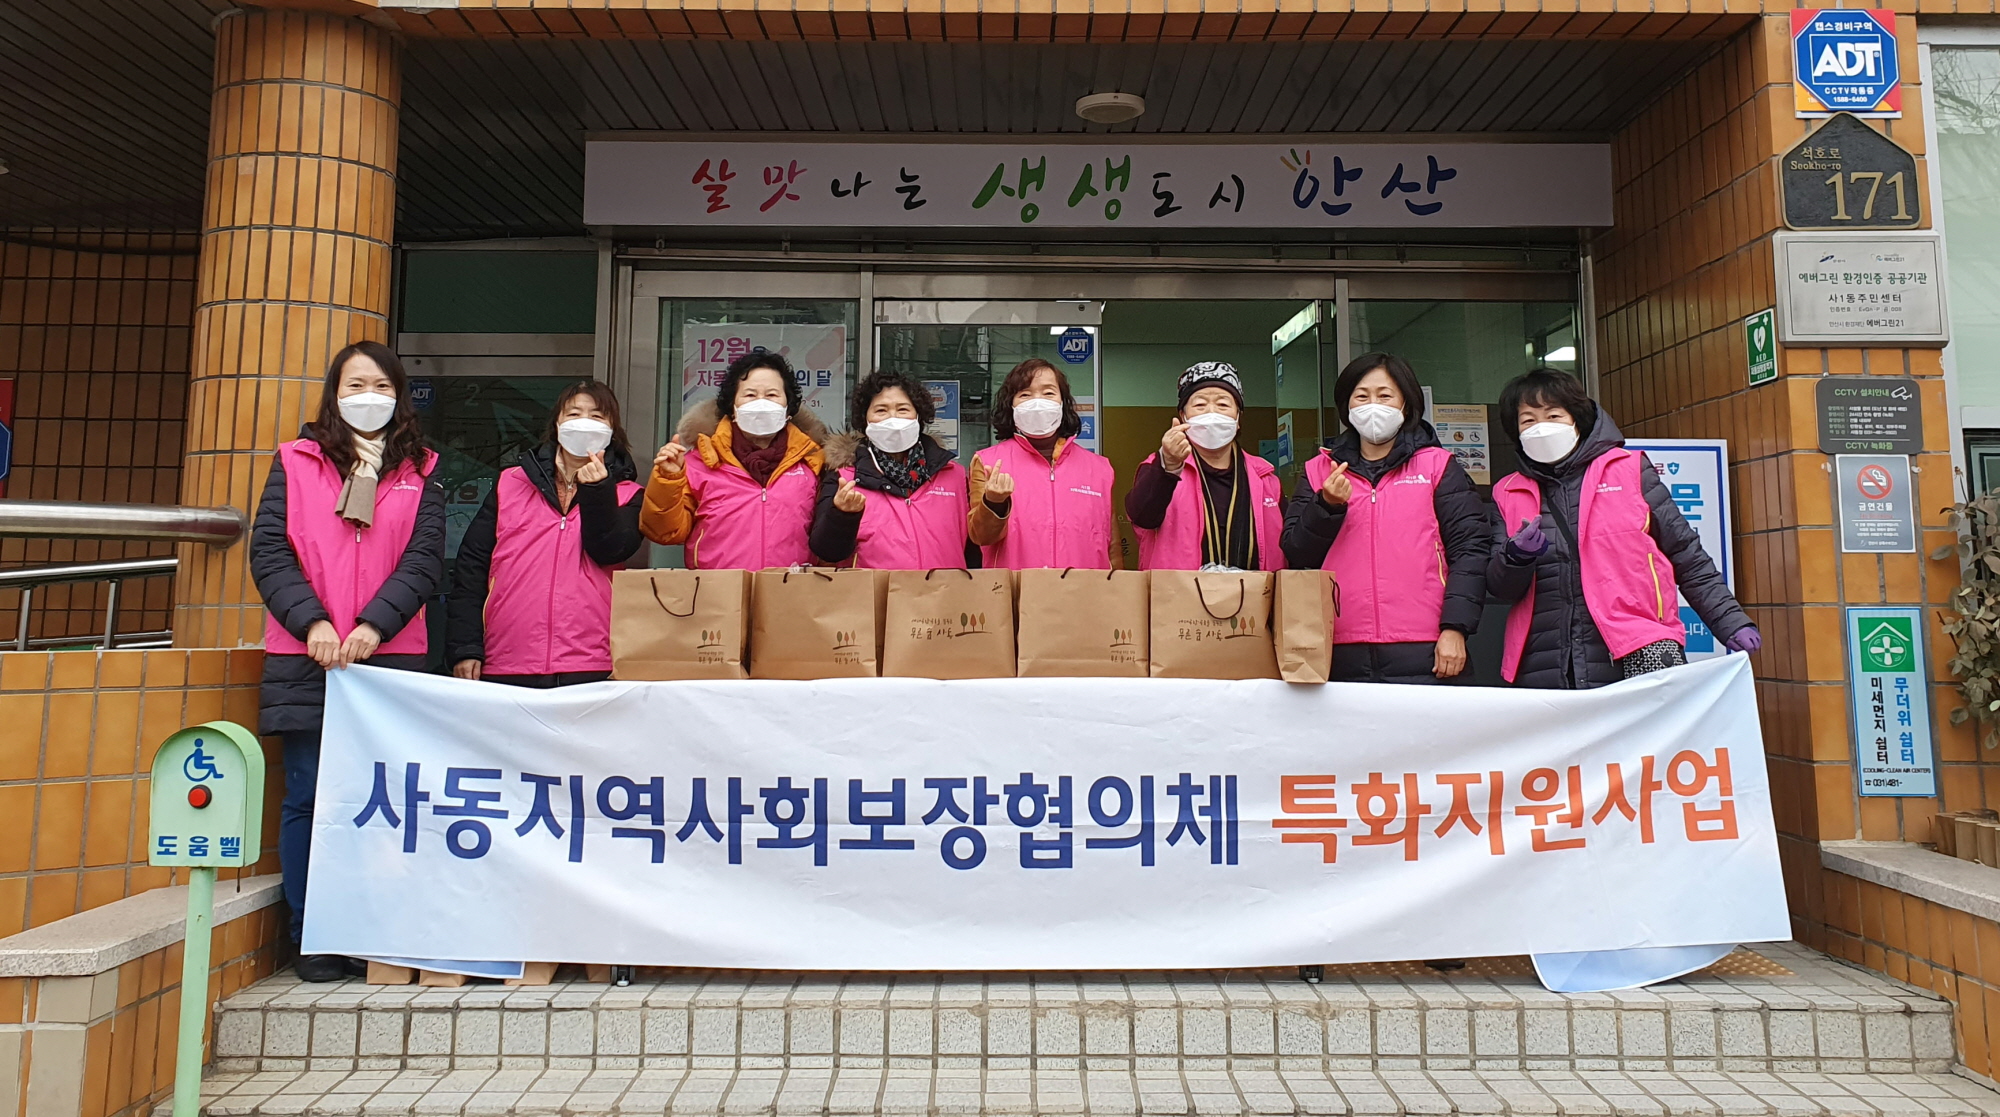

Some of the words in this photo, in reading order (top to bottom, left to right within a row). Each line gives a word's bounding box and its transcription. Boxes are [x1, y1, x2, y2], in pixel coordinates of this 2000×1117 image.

[1812, 42, 1881, 77] ADT
[1801, 146, 1842, 160] 석호로
[1285, 152, 1457, 217] 안산
[1825, 171, 1913, 220] 171
[1798, 272, 1839, 285] 에버그린
[1843, 272, 1883, 285] 환경인증
[1887, 272, 1928, 285] 공공기관
[1828, 293, 1902, 304] 사1동주민센터
[1866, 319, 1905, 328] 에버그린21
[1062, 338, 1089, 352] ADT
[1755, 352, 1767, 363] AED
[816, 370, 832, 387] 달
[411, 388, 432, 400] ADT
[1834, 388, 1858, 397] CCTV
[1845, 442, 1869, 450] CCTV
[1858, 502, 1893, 512] 금연건물
[1870, 676, 1886, 733] 미세먼지
[1894, 677, 1912, 727] 무더위
[1875, 736, 1889, 765] 쉼터
[1899, 731, 1915, 765] 쉼터
[351, 760, 1240, 871] 사동지역사회보장협의체
[1271, 746, 1740, 864] 특화지원사업
[156, 835, 241, 858] 도움벨
